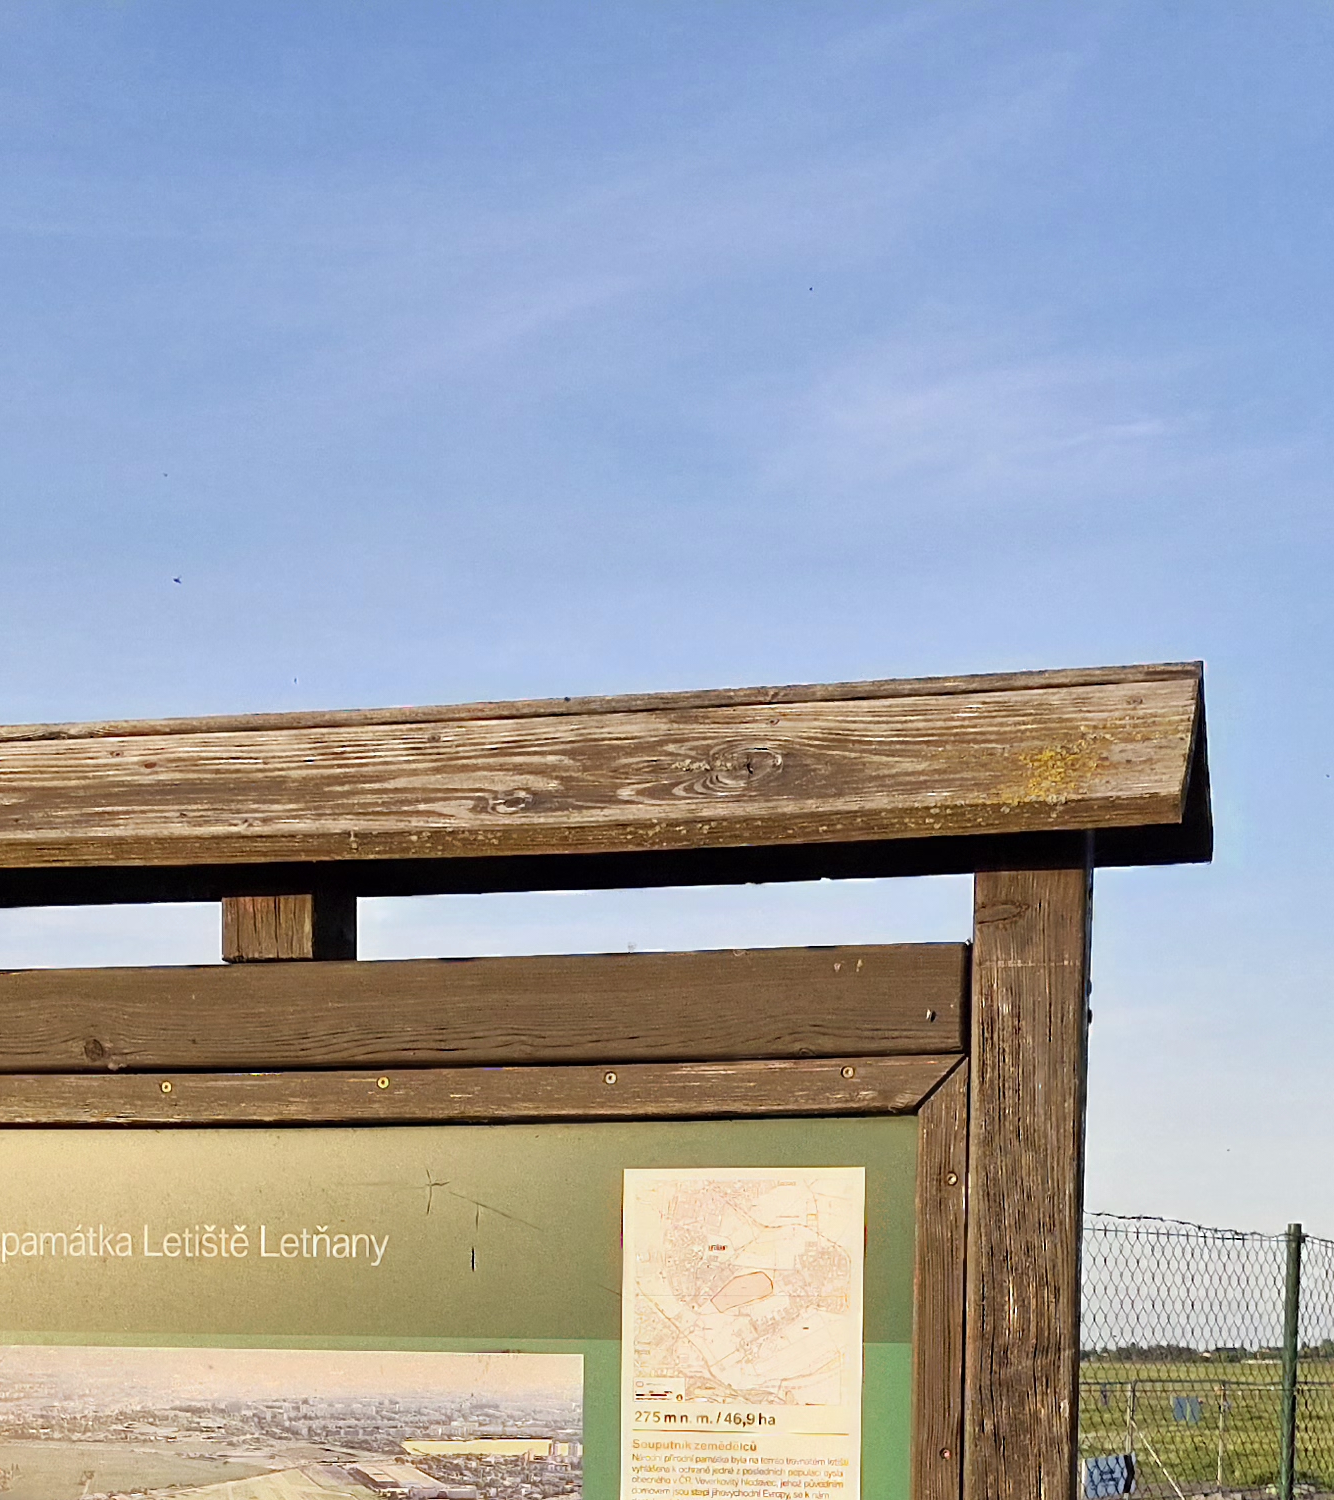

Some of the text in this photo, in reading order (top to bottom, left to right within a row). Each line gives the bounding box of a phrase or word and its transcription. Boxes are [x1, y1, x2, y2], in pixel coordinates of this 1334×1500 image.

[2, 1224, 133, 1262] památka
[144, 1223, 249, 1258] Letiště
[260, 1224, 389, 1266] Letňany
[635, 1411, 775, 1427] 275 m n. m. / 46,9 ha
